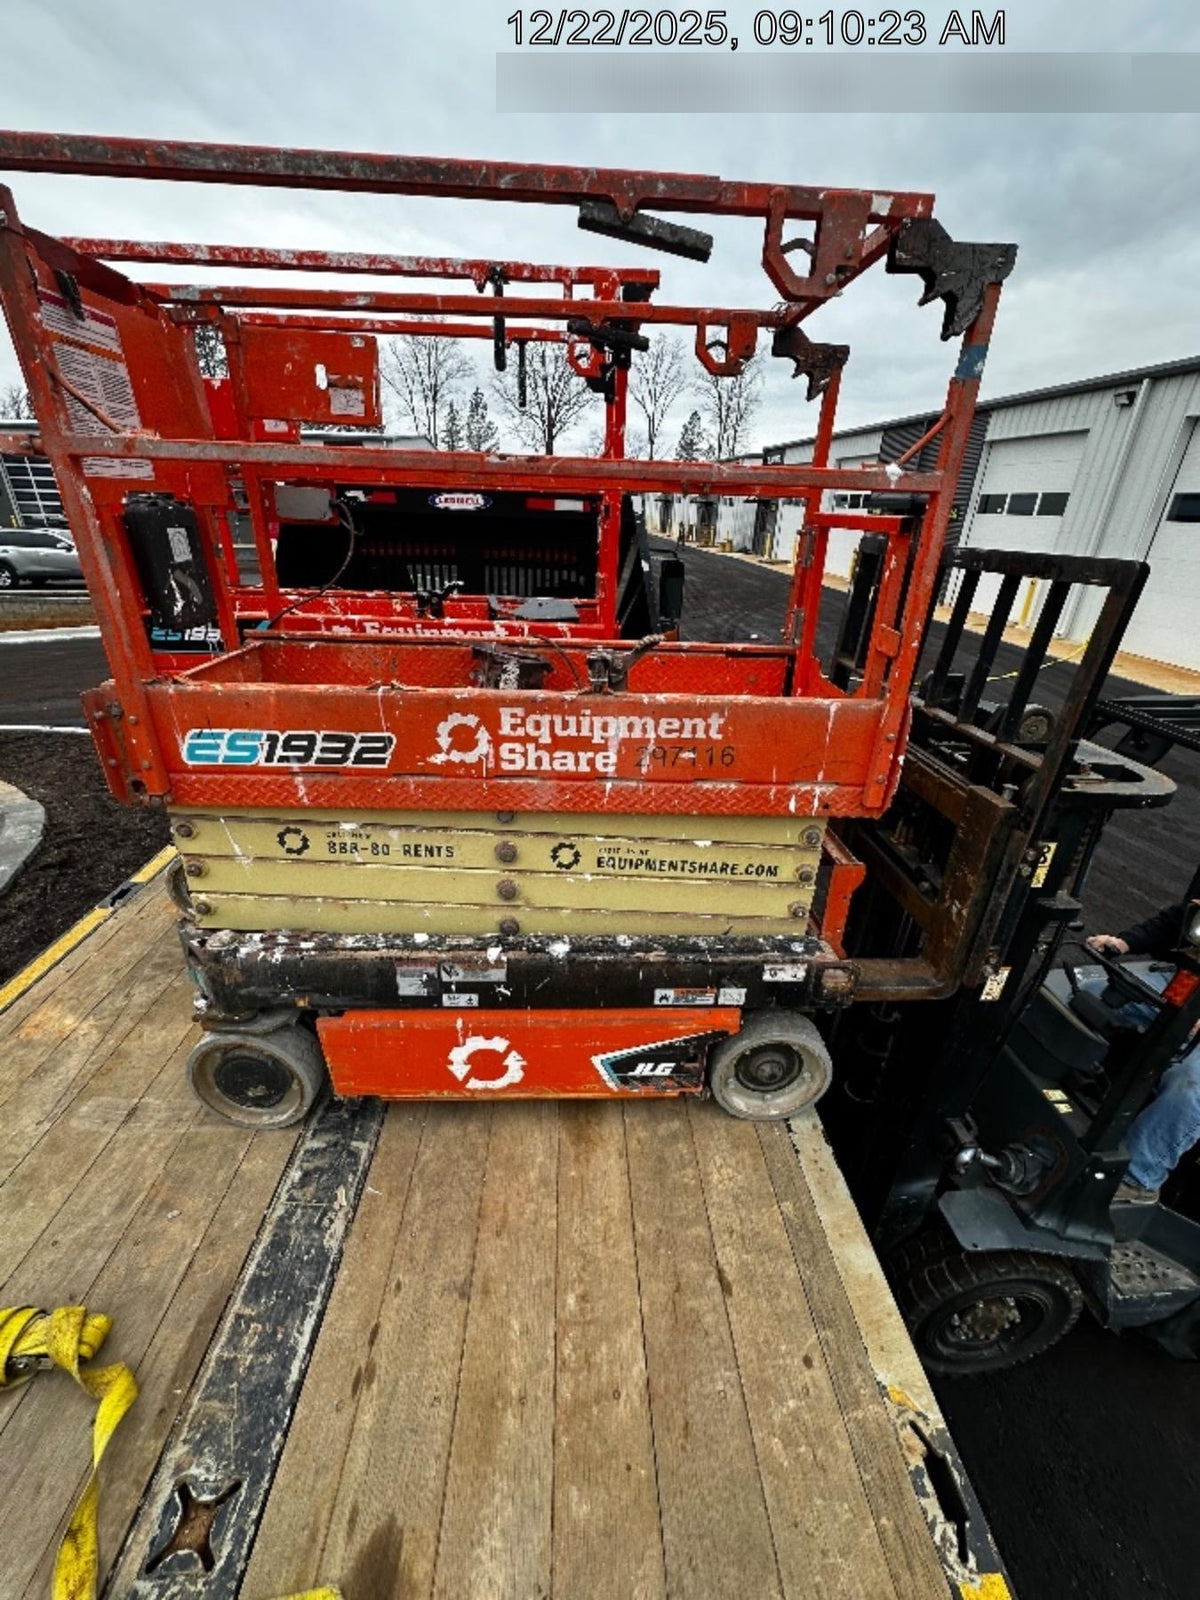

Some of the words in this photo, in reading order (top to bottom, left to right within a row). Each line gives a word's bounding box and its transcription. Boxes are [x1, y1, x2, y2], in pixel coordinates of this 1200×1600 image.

[498, 707, 724, 744] Equipment
[181, 729, 395, 768] ES1932
[499, 742, 617, 772] Share
[403, 843, 454, 858] RENTS
[596, 856, 779, 877] EQUIPMENTSHARE.COM
[627, 1062, 677, 1076] JLG
